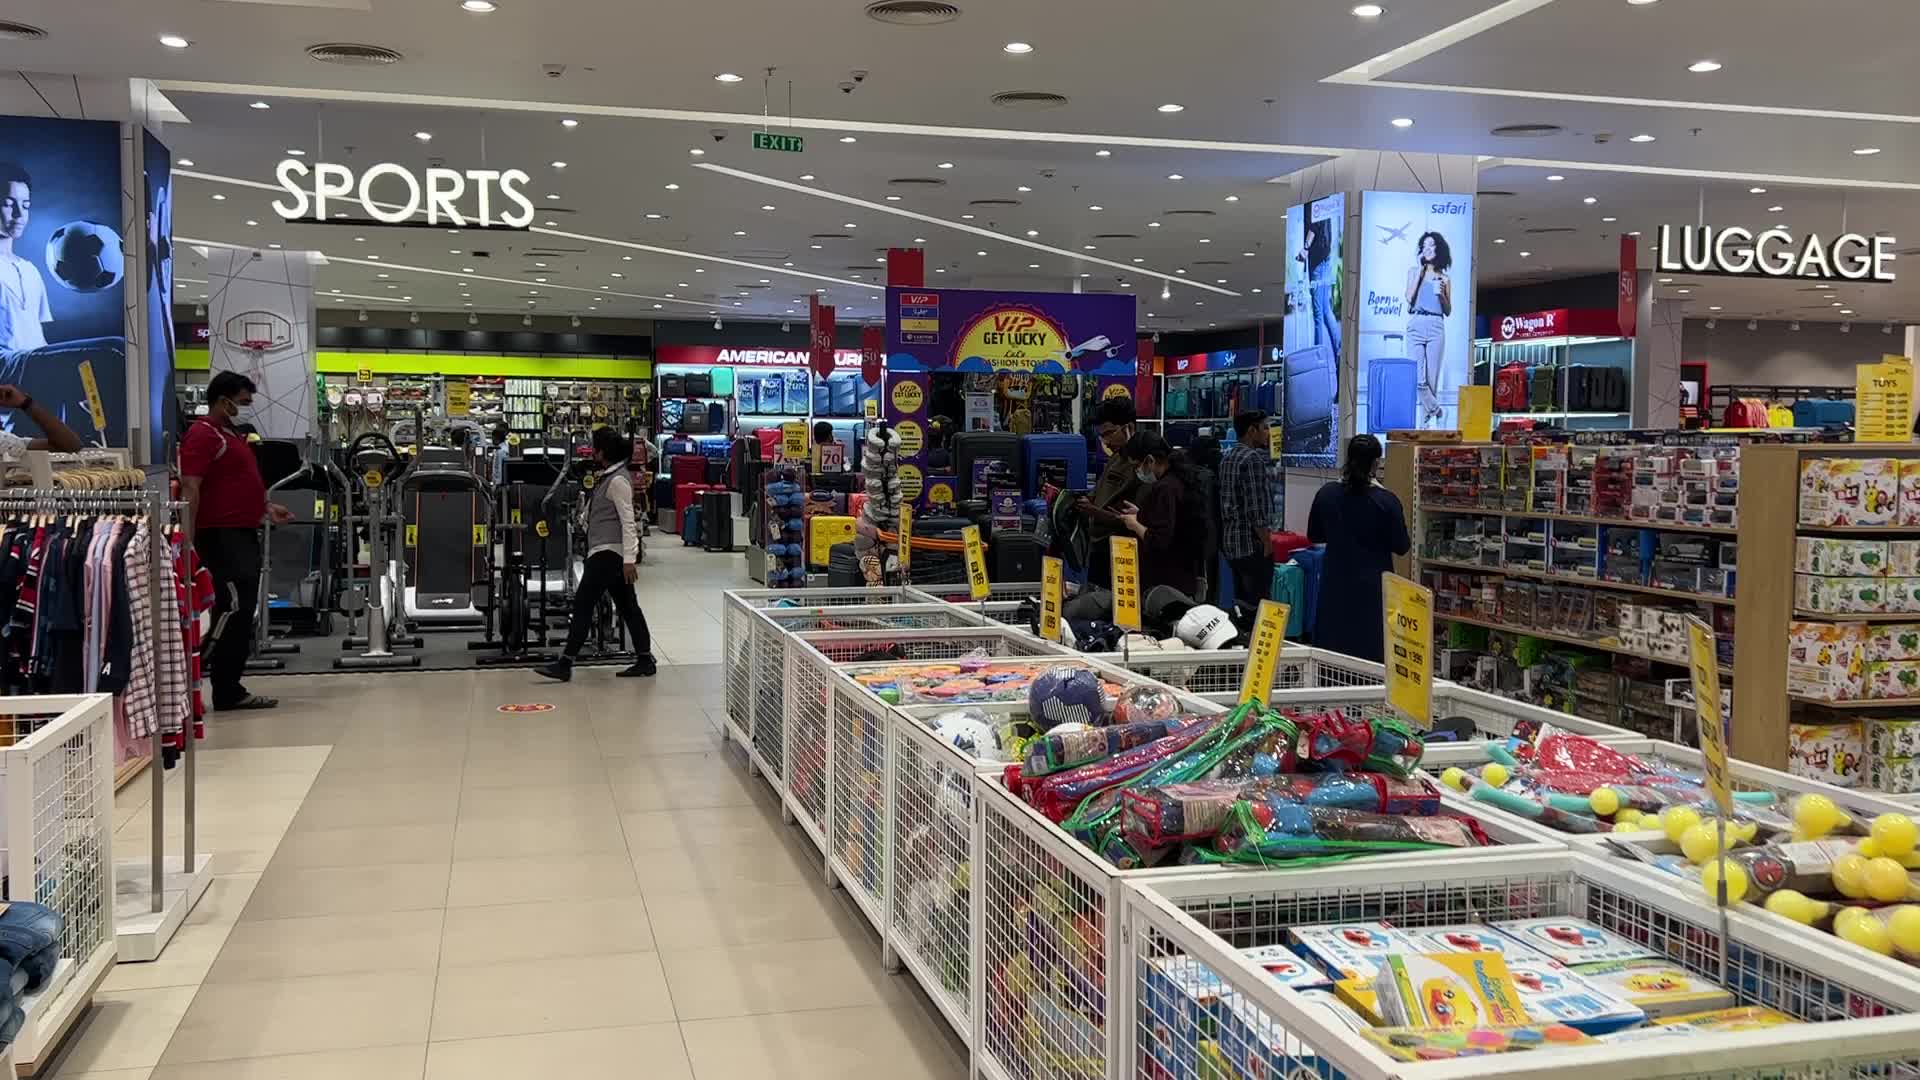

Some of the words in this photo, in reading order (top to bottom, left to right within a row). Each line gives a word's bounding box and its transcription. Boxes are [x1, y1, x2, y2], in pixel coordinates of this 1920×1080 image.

[760, 135, 797, 151] EXIT
[272, 159, 535, 228] SPORTS
[1431, 201, 1467, 216] safari
[1659, 224, 1896, 280] LUGGAGE
[910, 295, 928, 304] VIP
[1368, 291, 1392, 306] Born
[1373, 303, 1402, 316] travel
[994, 316, 1036, 332] VIP
[1515, 315, 1545, 333] Wagon
[983, 332, 1004, 345] GET
[1008, 332, 1047, 346] LUCKY
[717, 349, 810, 364] AMERICAN
[1872, 379, 1898, 388] TOYS
[823, 453, 840, 465] 70
[1397, 613, 1418, 632] TOYS
